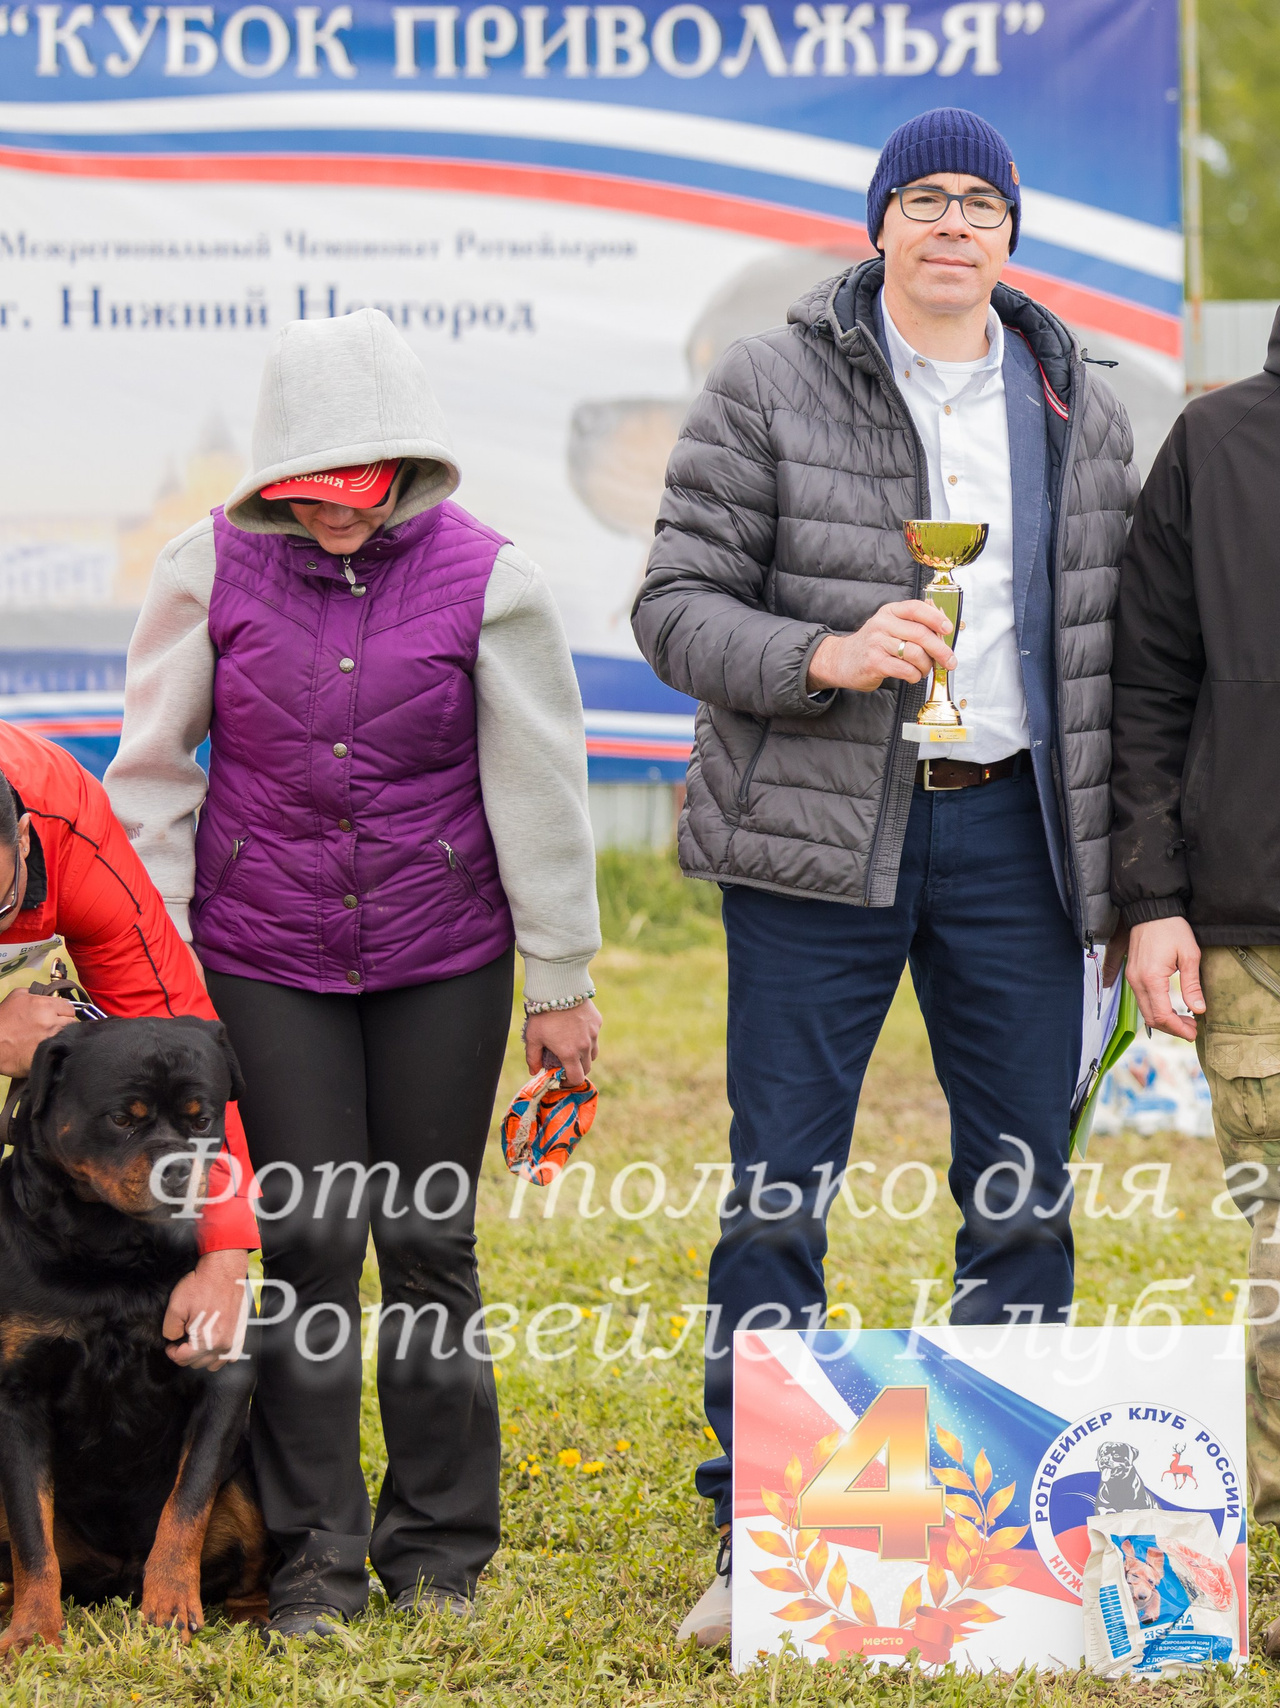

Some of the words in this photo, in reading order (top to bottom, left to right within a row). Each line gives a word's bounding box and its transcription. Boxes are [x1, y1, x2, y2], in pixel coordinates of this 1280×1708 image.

[60, 283, 268, 328] Нижний
[797, 1385, 946, 1562] 4
[1035, 1411, 1113, 1523] РОТВЕЙЛЕР
[1128, 1407, 1187, 1431] КЛУБ
[1194, 1430, 1240, 1519] РОССИИ
[1049, 1554, 1084, 1593] НИЖ
[862, 1637, 904, 1646] место
